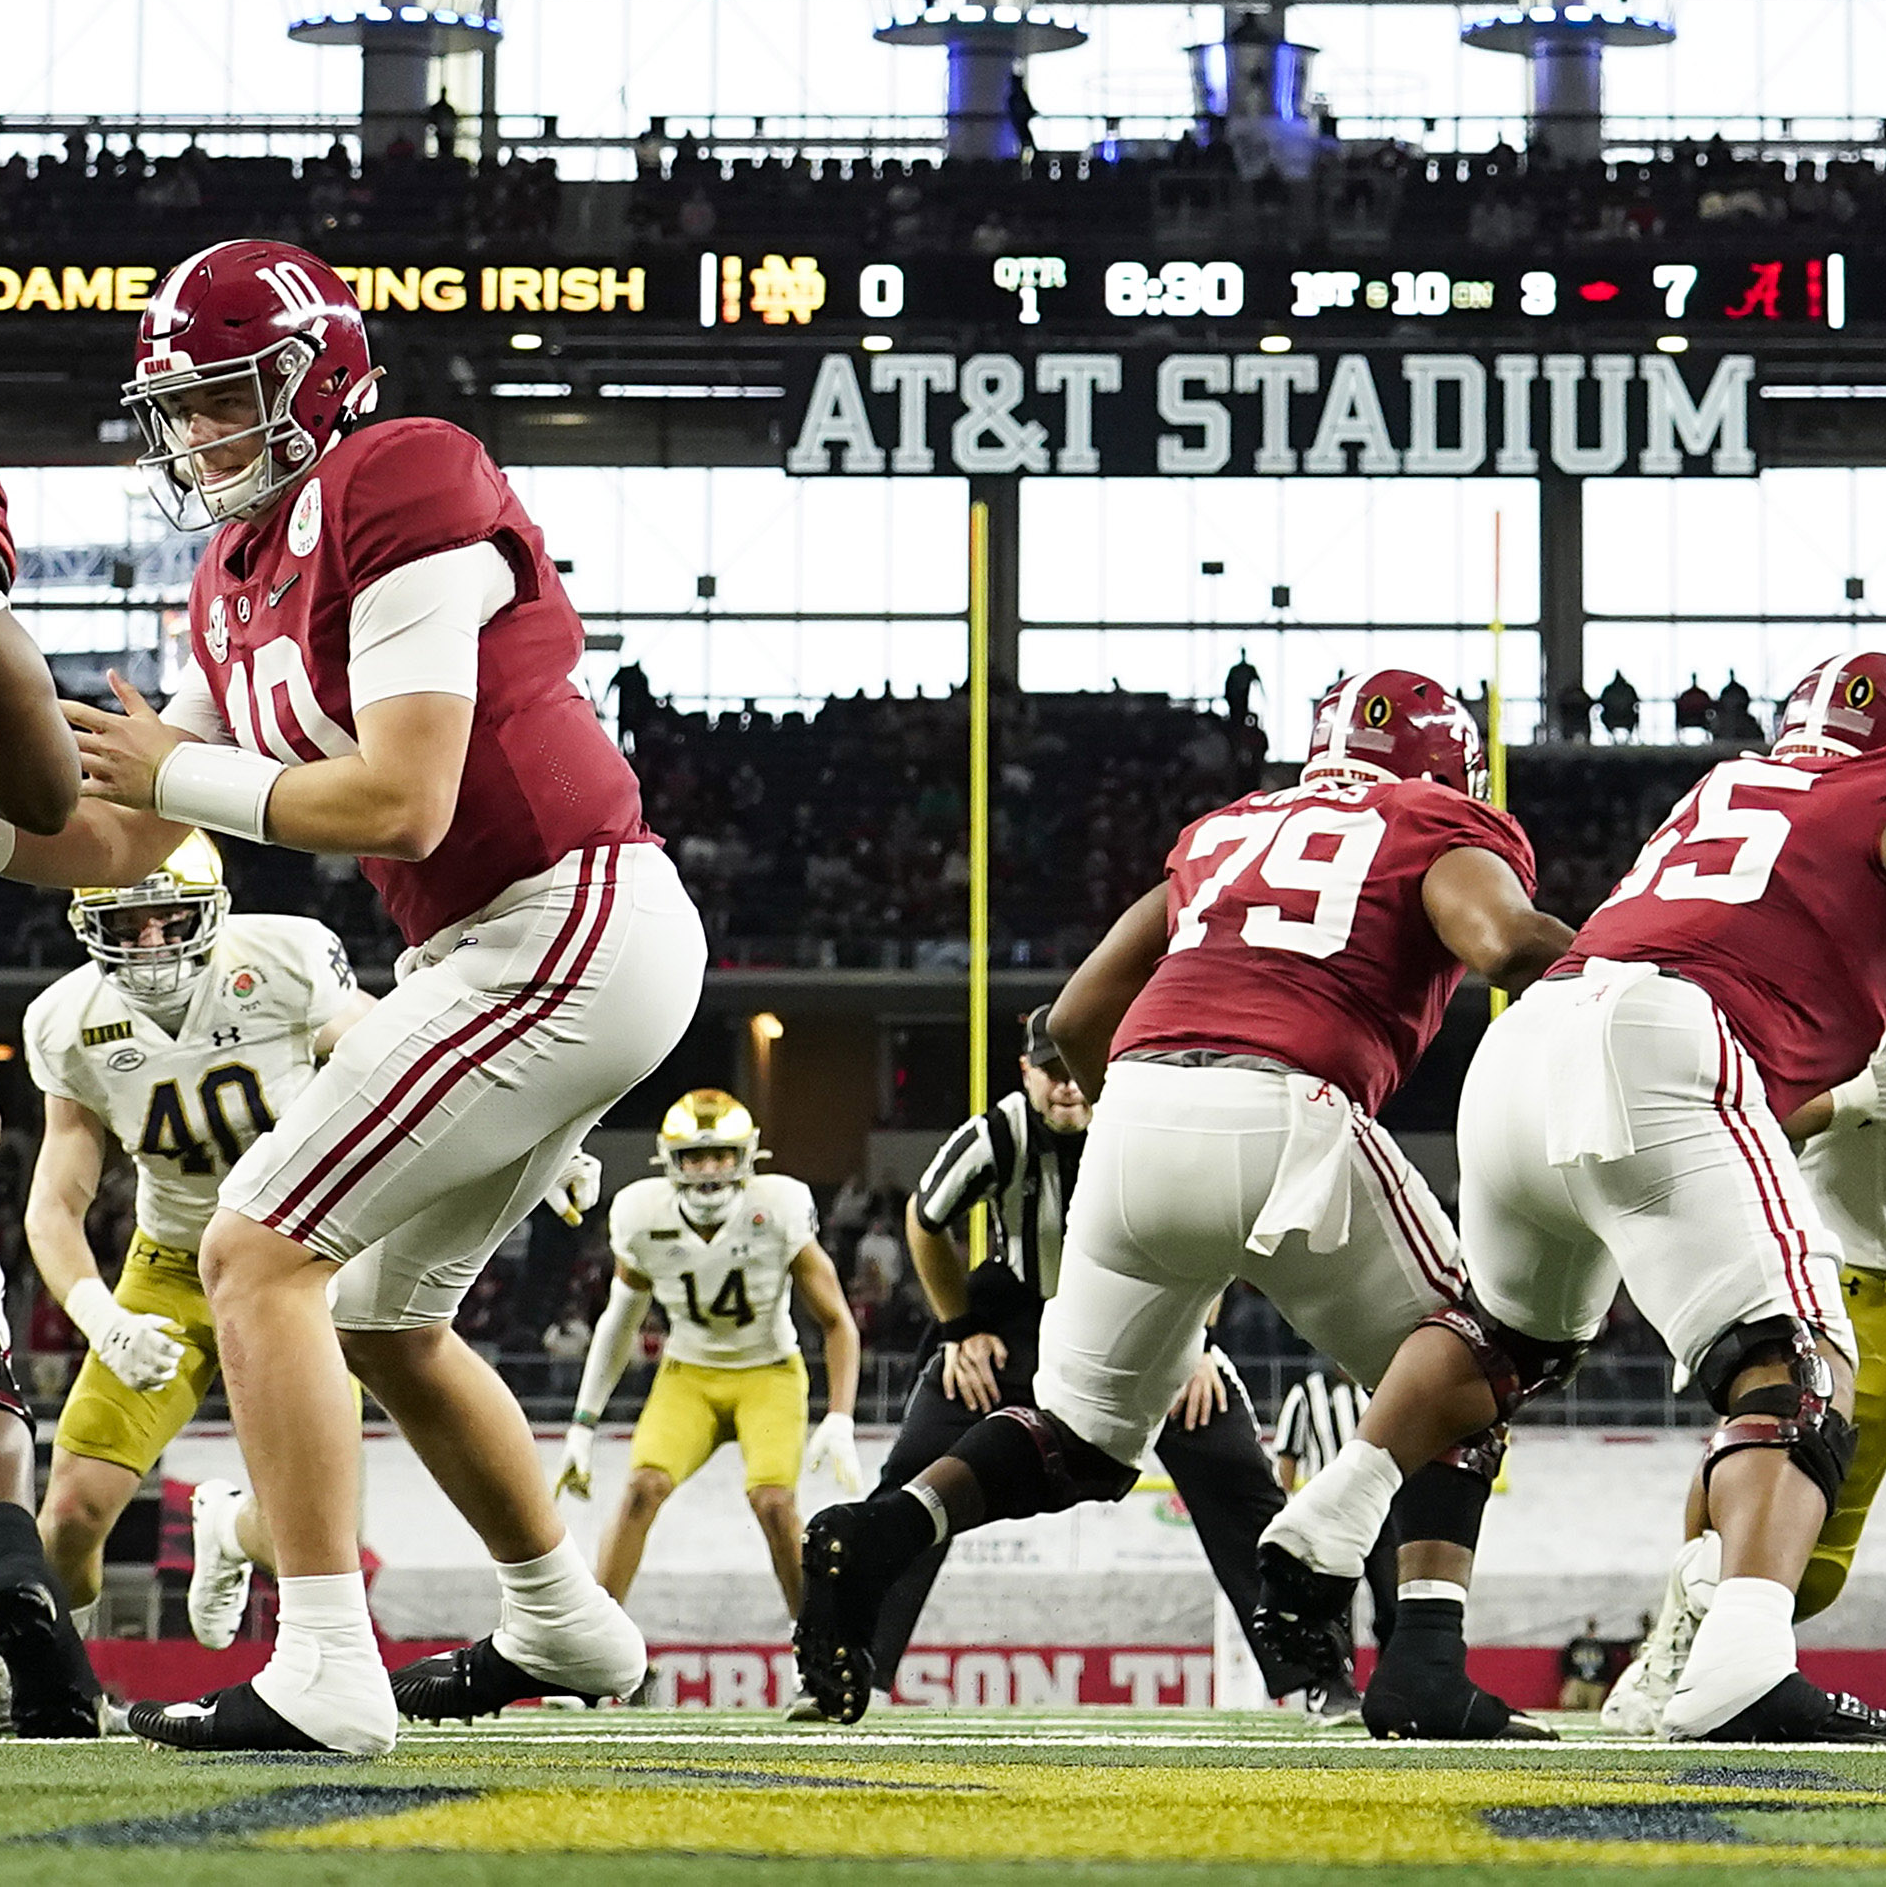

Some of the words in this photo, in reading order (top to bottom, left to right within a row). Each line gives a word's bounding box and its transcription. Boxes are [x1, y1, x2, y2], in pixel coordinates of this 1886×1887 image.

[481, 266, 645, 313] IRISH
[859, 264, 904, 317] 0
[993, 257, 1067, 291] QTR
[1392, 271, 1450, 316] 10
[1653, 264, 1697, 317] 7
[785, 353, 1122, 474] AT&T
[1157, 353, 1756, 475] STADIUM
[225, 634, 360, 766] 10
[1167, 805, 1388, 960] 79
[139, 1060, 279, 1177] 40
[680, 1268, 756, 1328] 14
[658, 1652, 1082, 1708] CRISON
